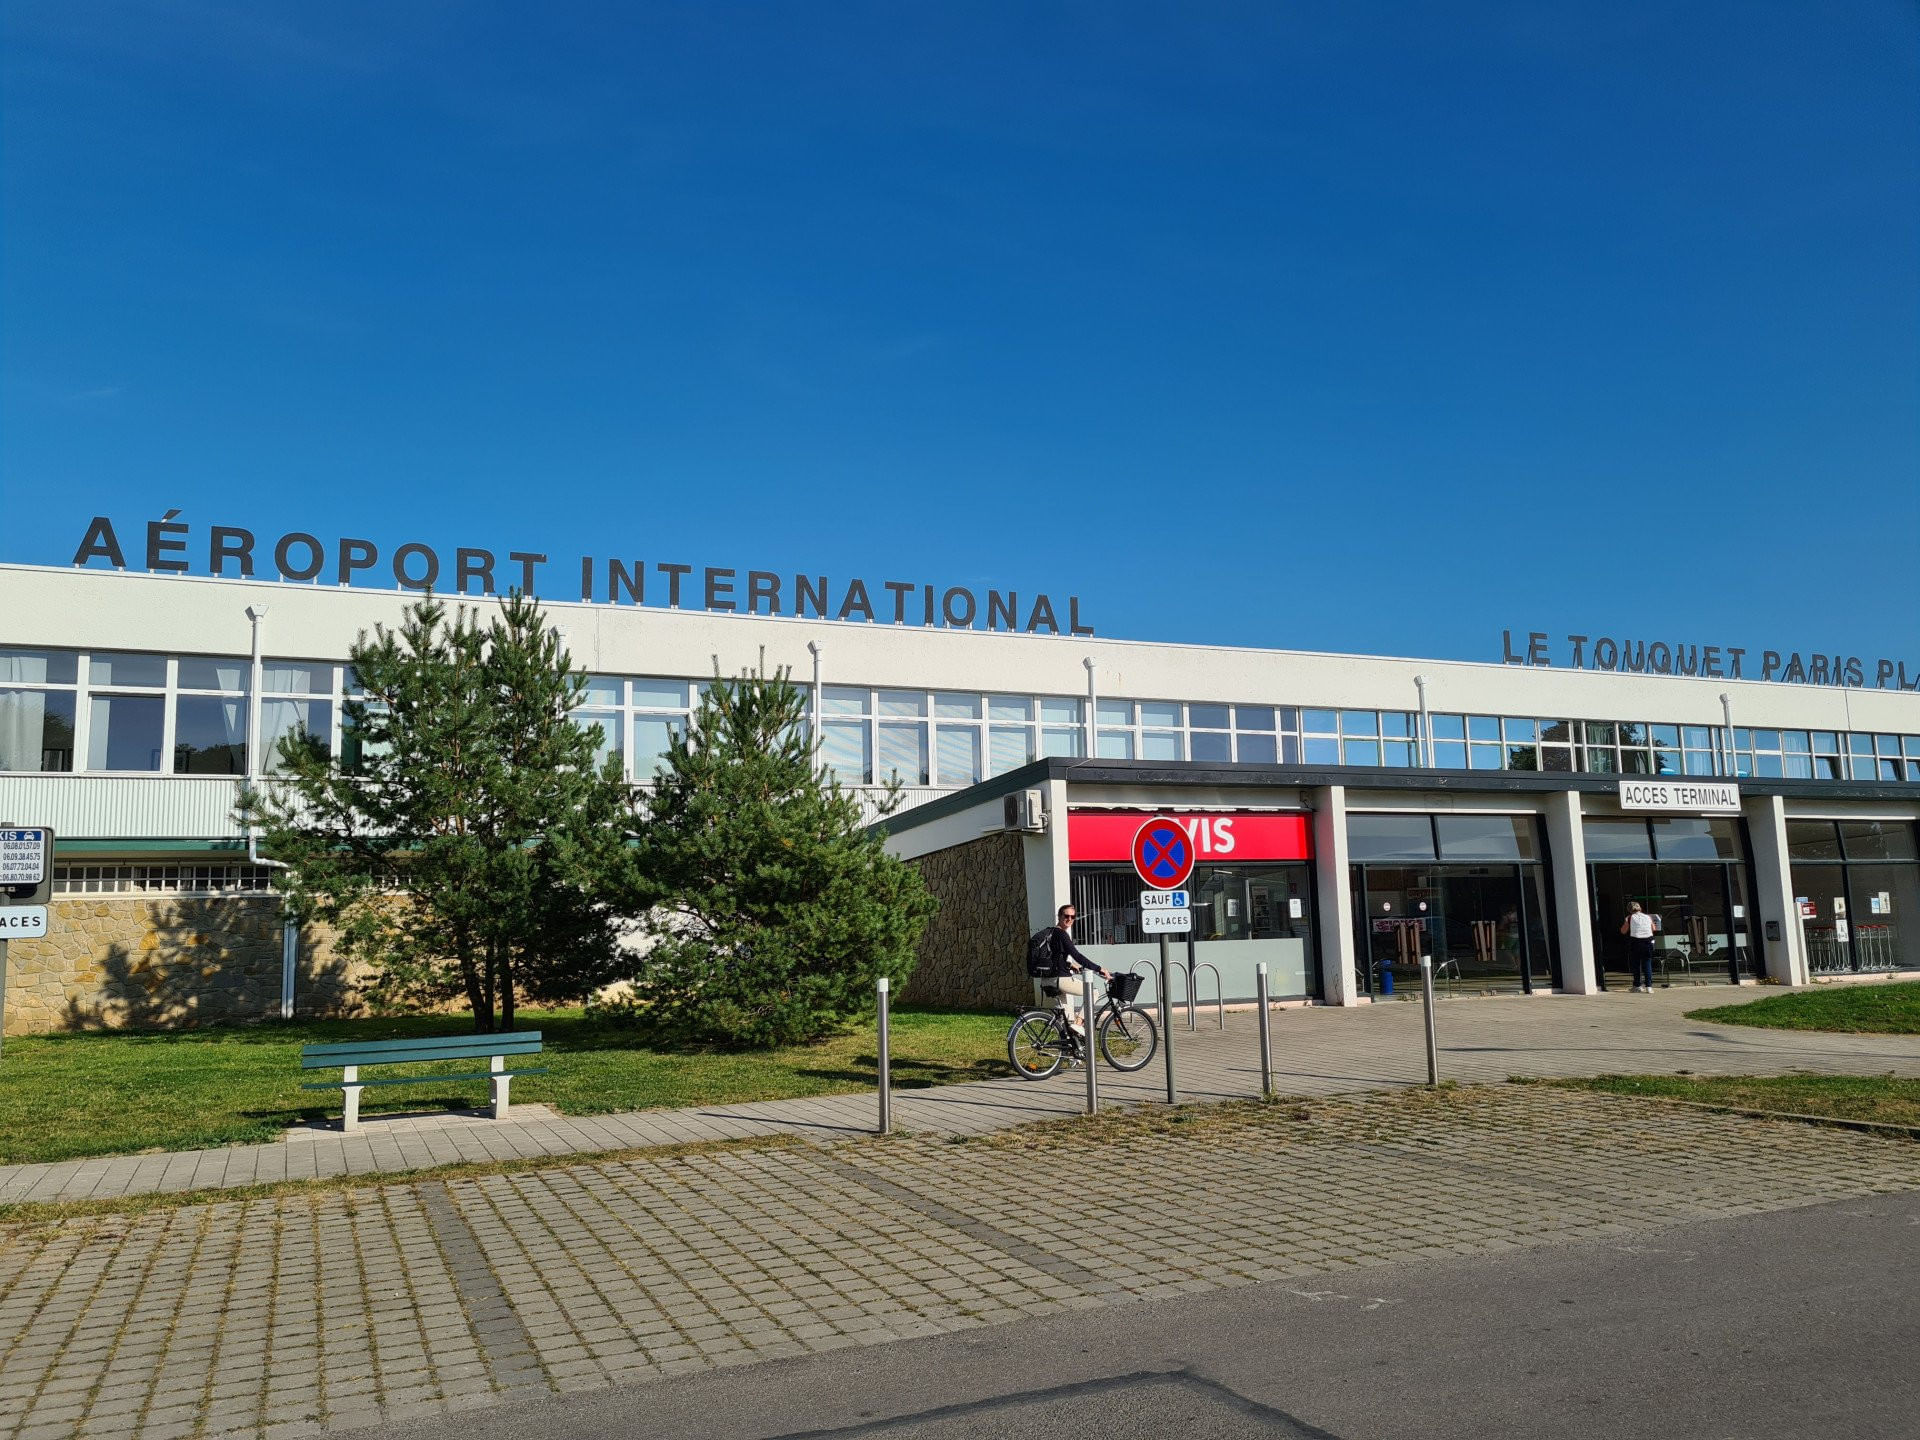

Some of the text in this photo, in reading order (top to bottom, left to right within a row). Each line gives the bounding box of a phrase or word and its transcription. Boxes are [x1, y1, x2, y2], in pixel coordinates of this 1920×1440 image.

[73, 509, 1094, 634] AÉROPORT INTERNATIONAL
[1503, 630, 1920, 690] LE TOUQUET PARIS PL
[1626, 786, 1736, 805] ACCES TERMINAL
[1144, 894, 1170, 905] SAUF
[1145, 916, 1188, 926] 2 PLACES
